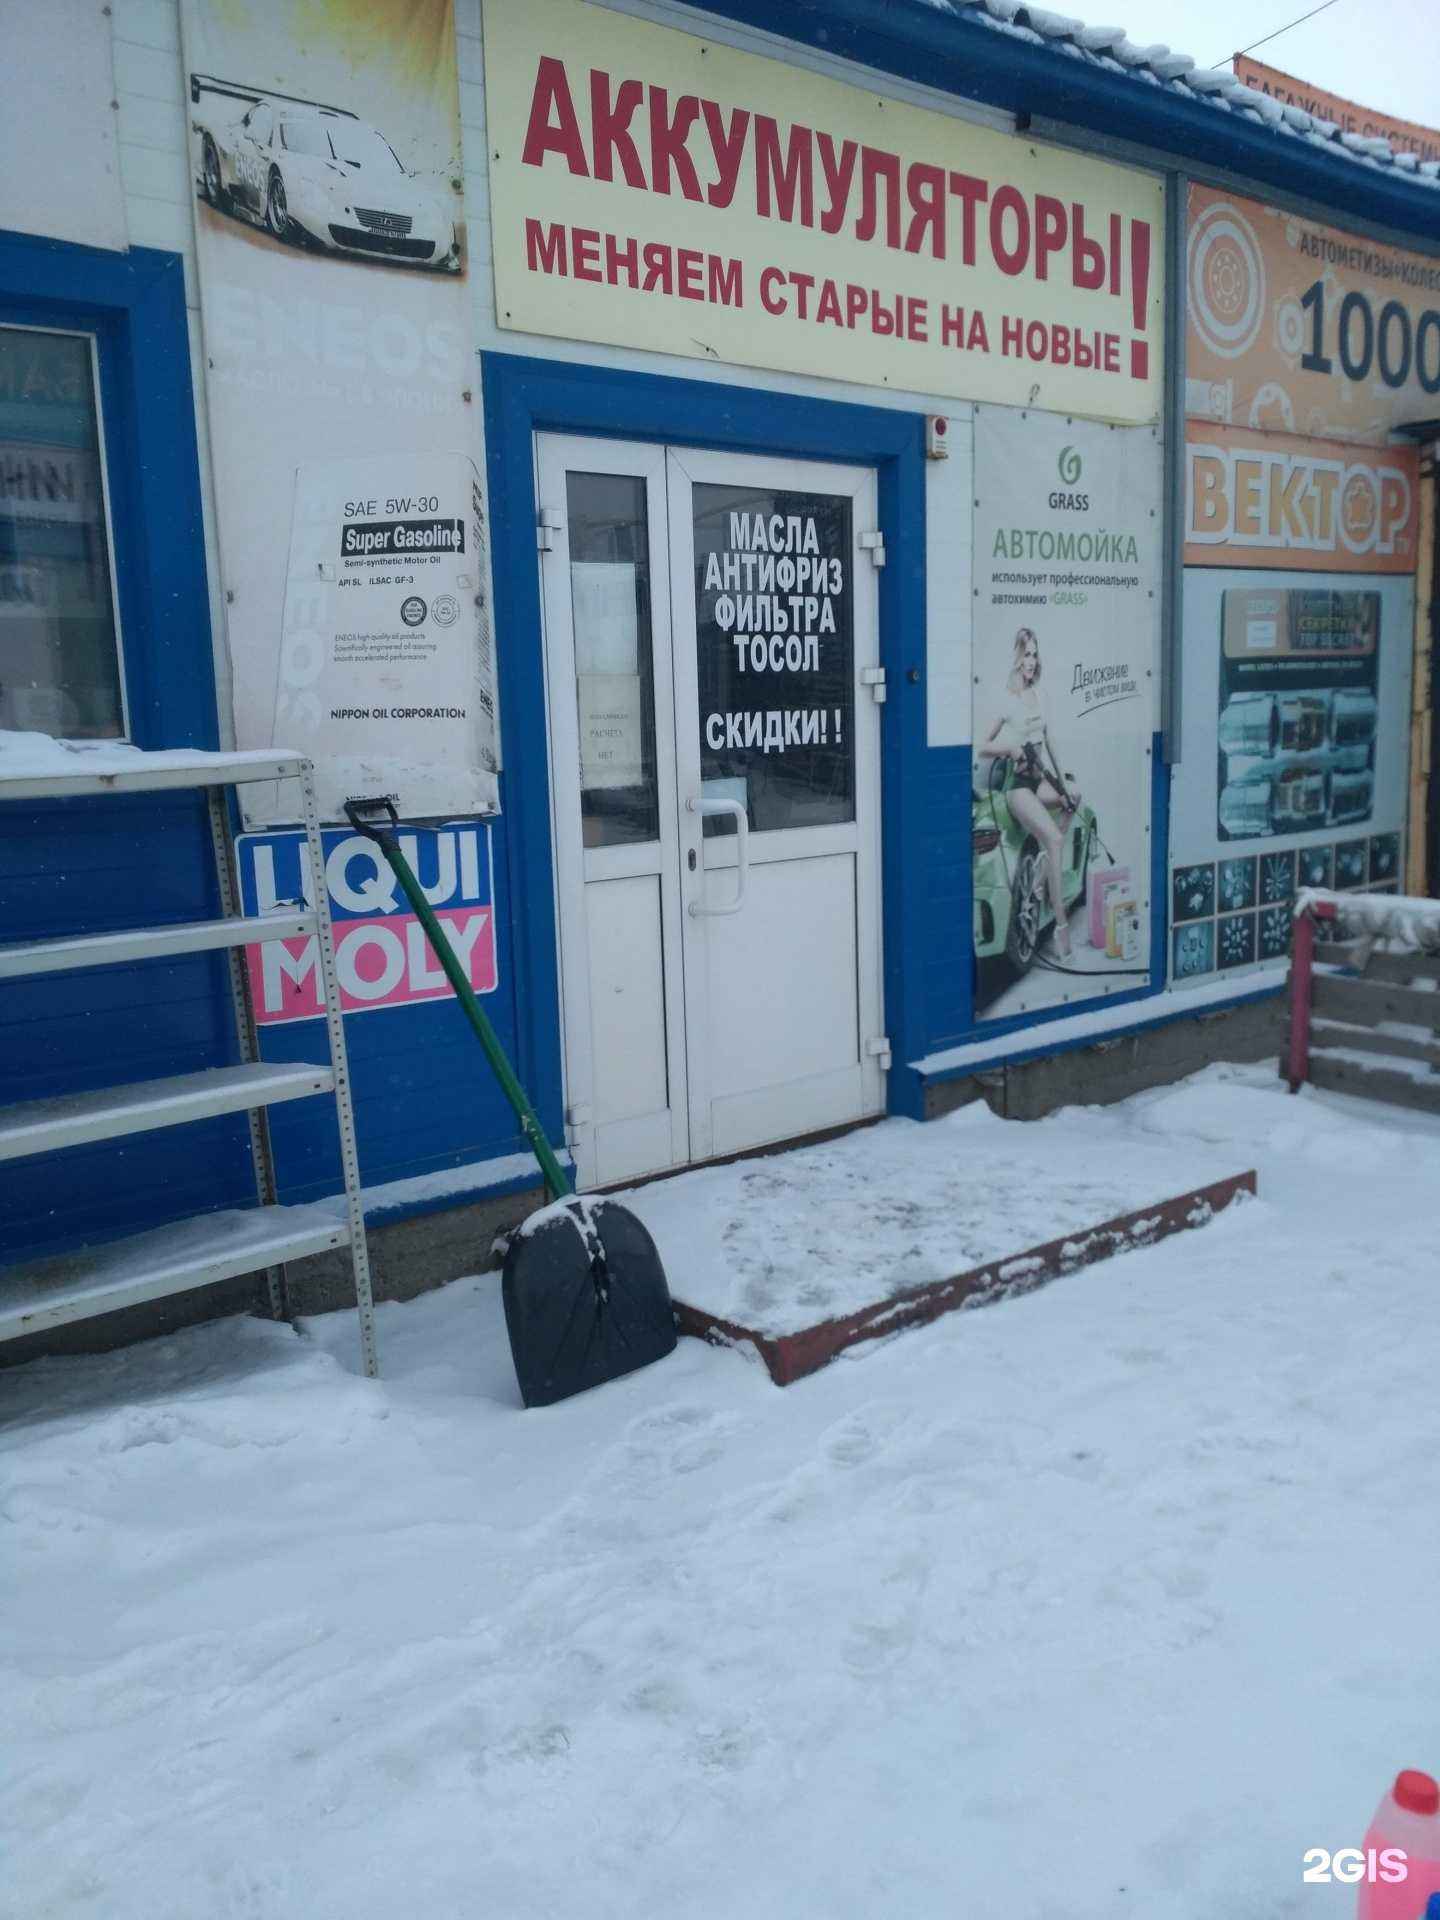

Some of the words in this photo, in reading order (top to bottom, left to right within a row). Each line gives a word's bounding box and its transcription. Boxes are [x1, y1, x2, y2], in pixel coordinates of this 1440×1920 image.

[525, 218, 743, 308] МЕНЯЕМ
[759, 266, 929, 343] СТАРЫЕ
[941, 306, 990, 353] НА
[1001, 315, 1121, 373] НОВЫЕ
[211, 283, 465, 383] ENEOS
[343, 501, 377, 518] SAE
[385, 496, 439, 514] 5W-30
[1048, 492, 1090, 511] GRASS
[1187, 446, 1409, 554] ВЕКТОР
[345, 528, 391, 555] Super
[393, 524, 462, 548] Gasoline
[730, 511, 820, 554] МАСЛА
[992, 527, 1138, 563] АВТОМОЙКА
[344, 559, 402, 568] Semi-synthetic
[404, 557, 427, 566] Motor
[429, 556, 441, 564] Oil
[394, 576, 415, 584] GF-3
[704, 552, 843, 595] АНТИФРИЗ
[991, 572, 1047, 587] использует
[1049, 572, 1139, 588] профессиональную
[715, 594, 836, 633] ФИЛЬТРА
[991, 593, 1047, 605] автохимию
[733, 634, 819, 672] ТОСОЛ
[330, 708, 369, 719] NIPPON
[372, 708, 388, 719] OIL
[391, 707, 465, 719] CORPORATION
[252, 831, 481, 917] LIQUI
[260, 914, 489, 1013] MOLY
